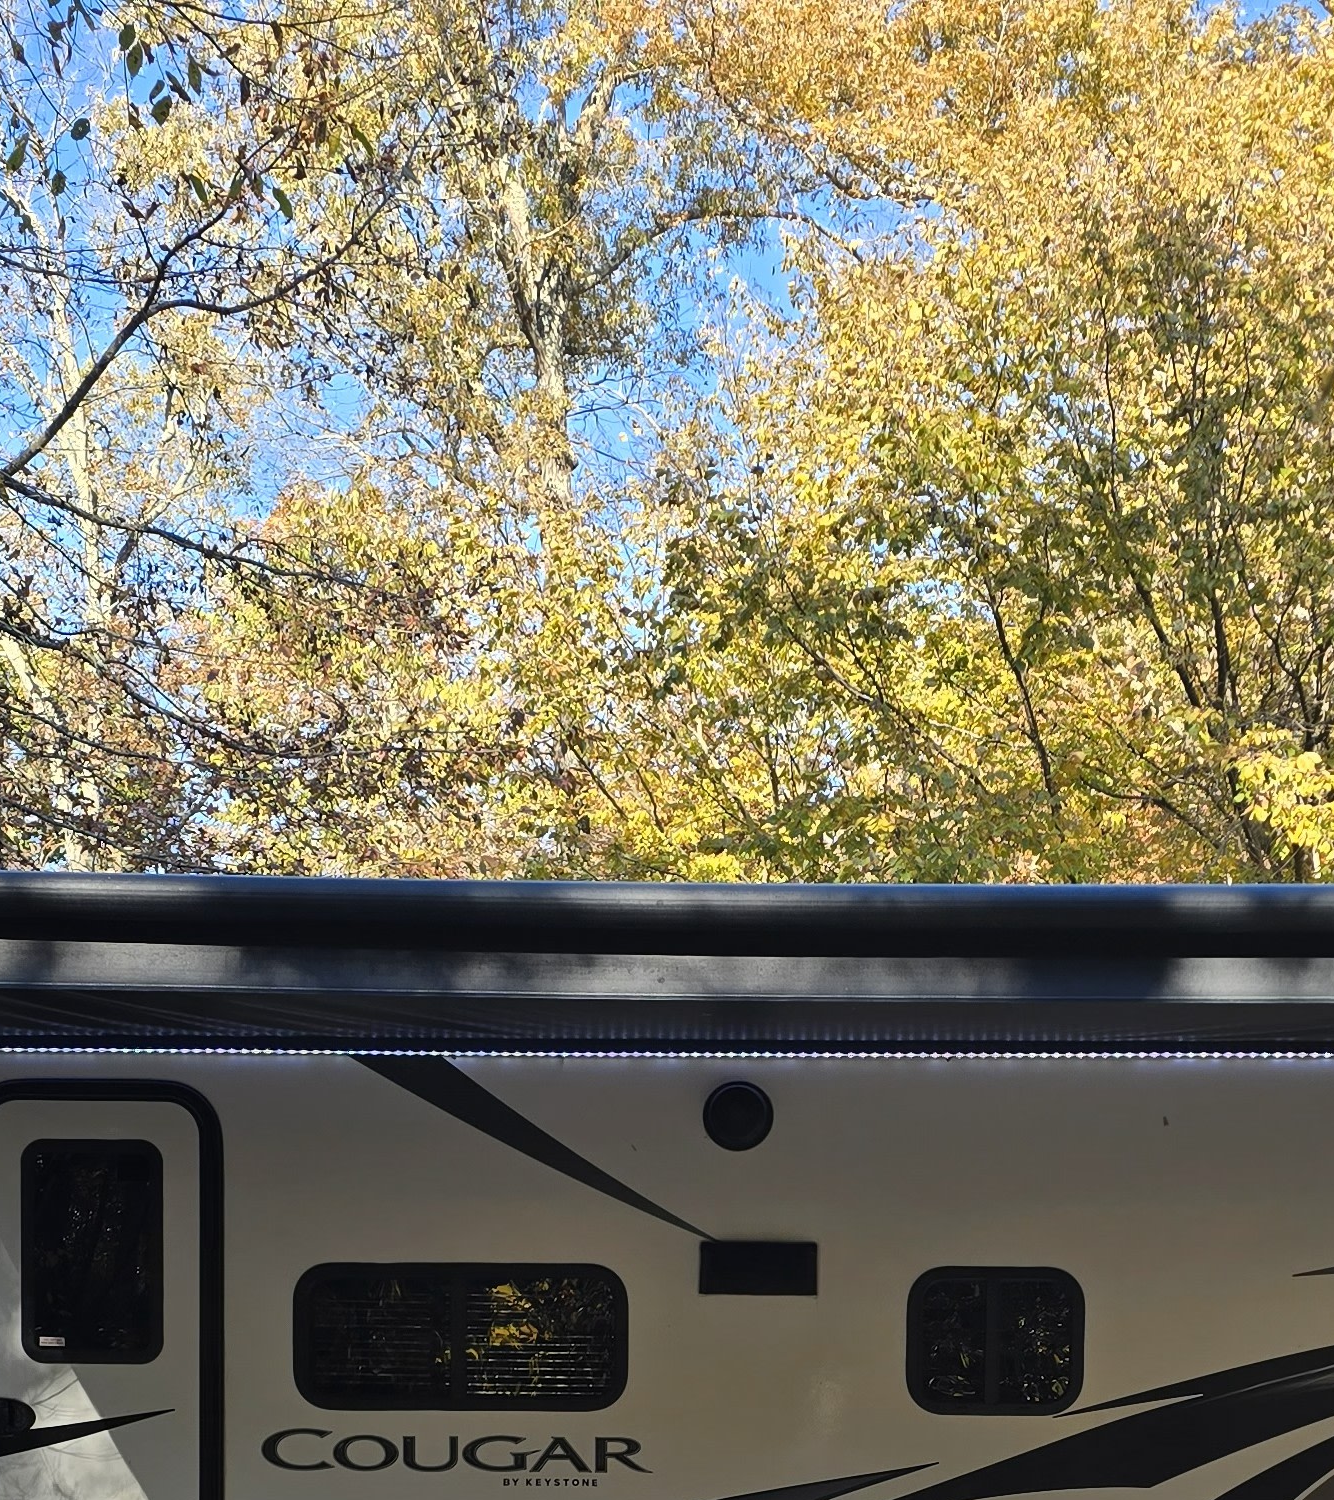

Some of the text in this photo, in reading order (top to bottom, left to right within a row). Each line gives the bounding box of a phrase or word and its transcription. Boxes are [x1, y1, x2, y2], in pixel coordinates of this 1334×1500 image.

[261, 1428, 653, 1473] COUGAR
[503, 1478, 598, 1487] BY KEYSTONE
